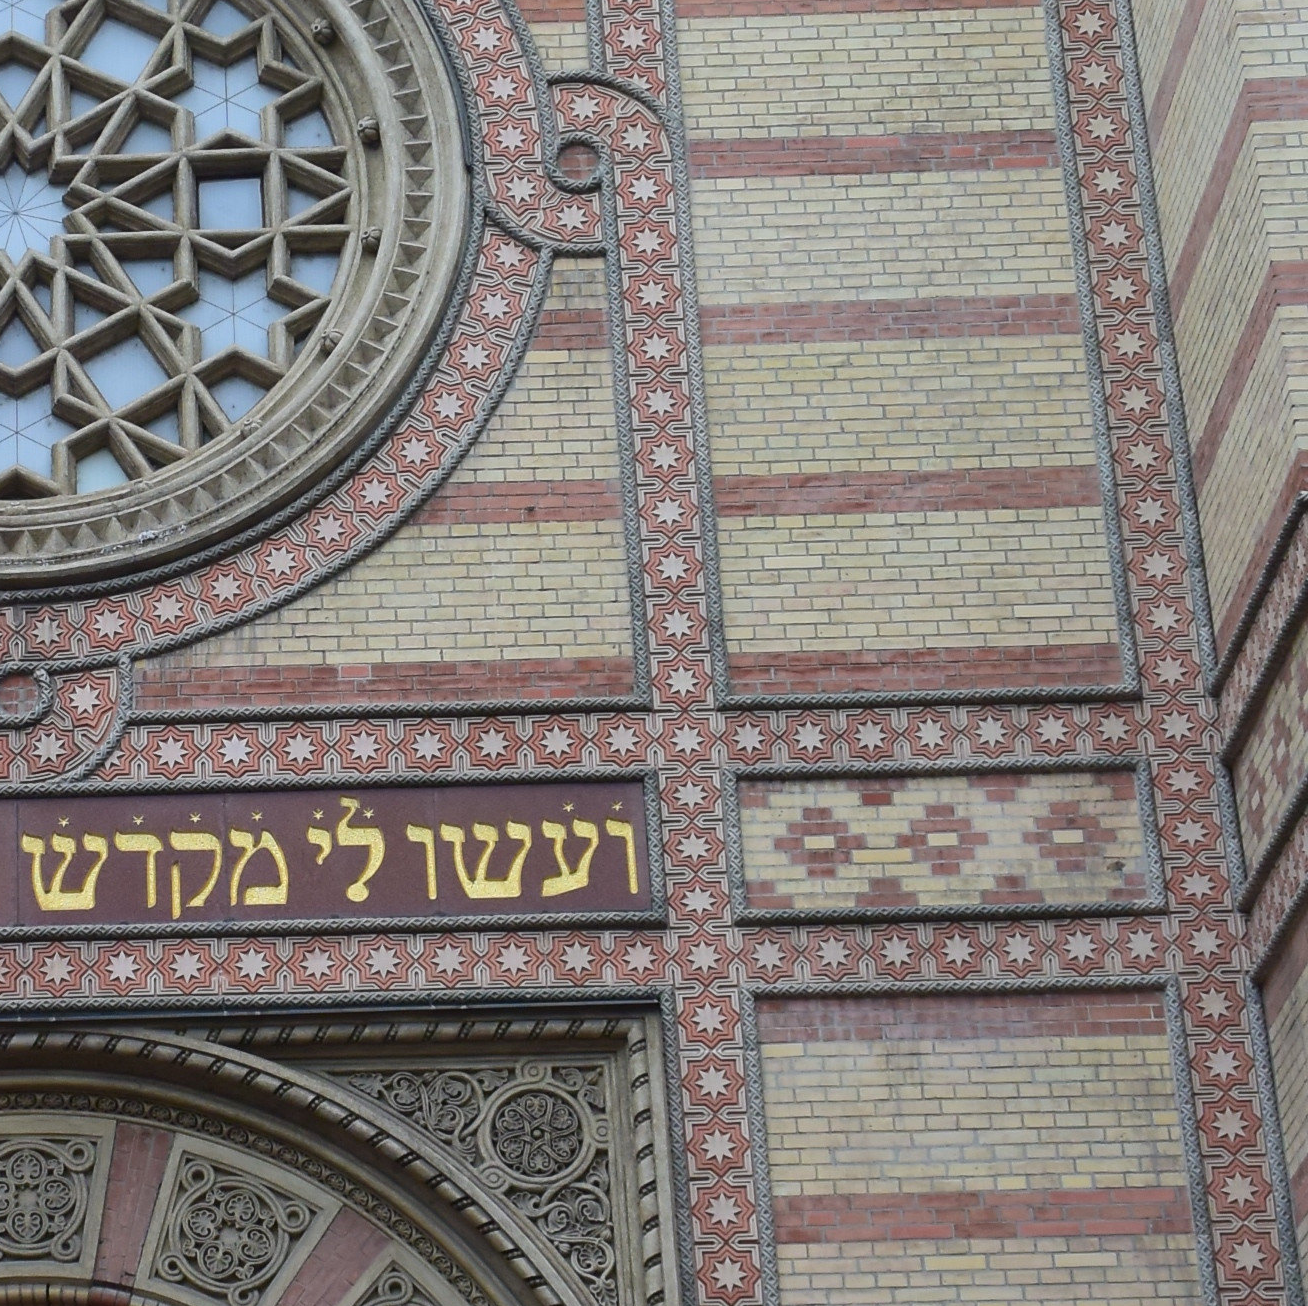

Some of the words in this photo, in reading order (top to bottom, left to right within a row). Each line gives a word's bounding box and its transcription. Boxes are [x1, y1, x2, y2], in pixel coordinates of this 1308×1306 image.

[20, 829, 290, 920] מקדש
[306, 797, 386, 902] לי
[405, 819, 639, 898] ועשו
